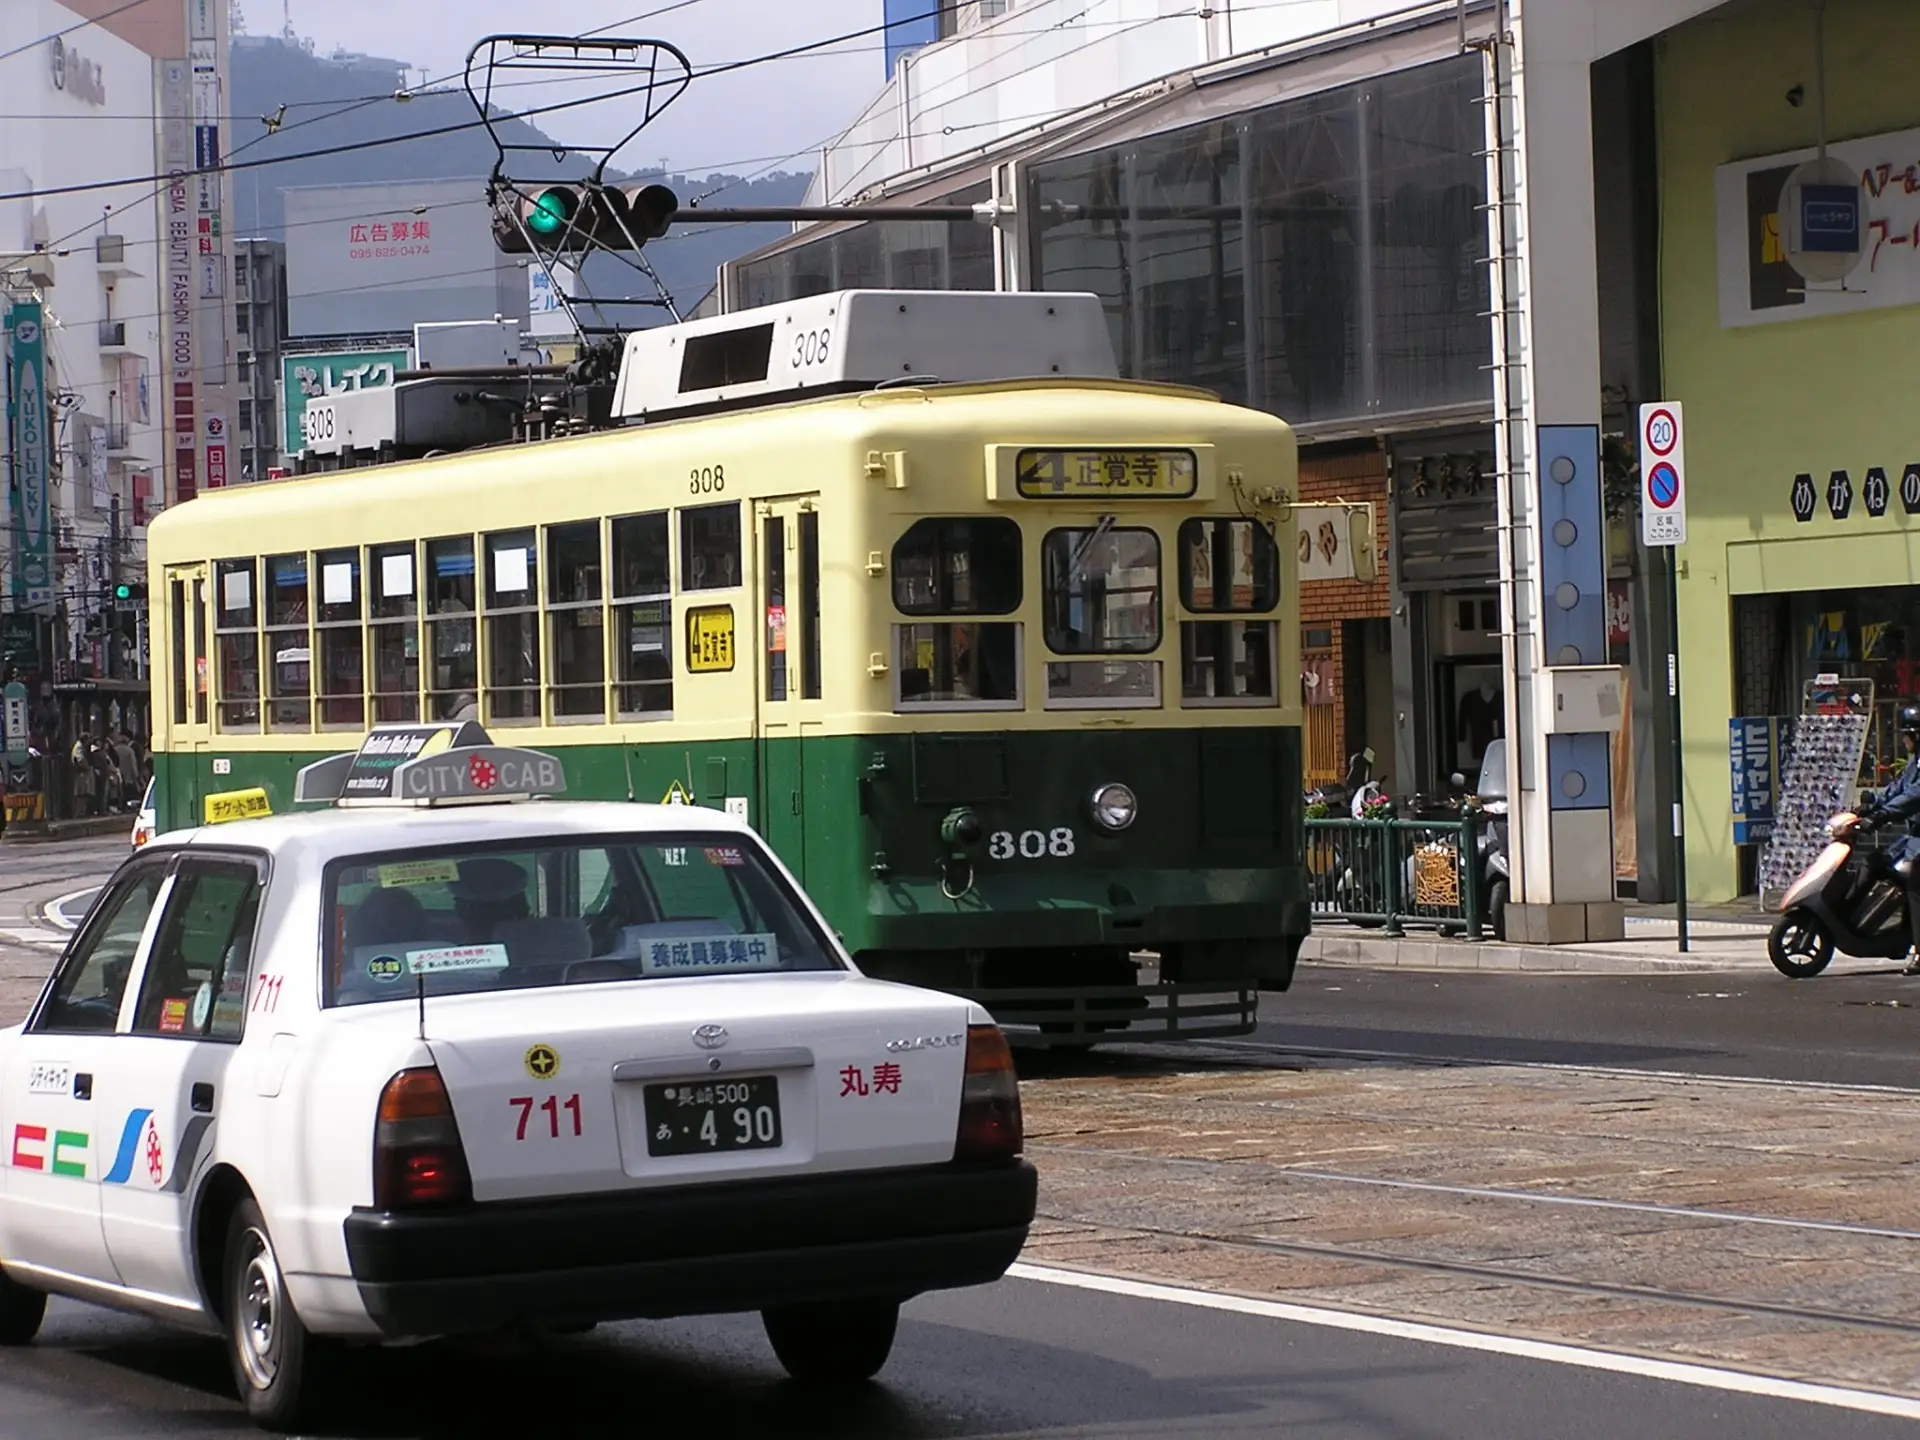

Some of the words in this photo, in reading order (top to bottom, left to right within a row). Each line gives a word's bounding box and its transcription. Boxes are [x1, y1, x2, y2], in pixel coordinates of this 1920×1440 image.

[170, 169, 187, 213] CNEMA
[170, 221, 187, 265] BEAUTY
[350, 221, 431, 243] 広告募集
[350, 245, 430, 259] 095-825-0474
[173, 274, 190, 325] FASHION
[175, 331, 190, 364] FOOD
[792, 328, 831, 369] 308
[323, 361, 394, 398] レイク
[23, 389, 36, 444] YUKO
[308, 407, 334, 442] 308
[1652, 422, 1671, 443] 20
[25, 454, 38, 519] LUCKY
[690, 464, 725, 494] 308
[1076, 453, 1188, 488] 正覚寺下
[1795, 473, 1920, 514] めがねの
[1650, 528, 1680, 538] ここから
[692, 613, 701, 663] 4
[409, 764, 465, 794] CITY
[501, 759, 556, 788] CAB
[1745, 724, 1769, 811] ヒラヤマ
[989, 827, 1075, 859] 308
[652, 939, 767, 968] 養成員募集中
[252, 974, 283, 1013] 711
[840, 1062, 902, 1097] 丸寿
[509, 1093, 582, 1141] 711
[656, 1122, 672, 1140] あ
